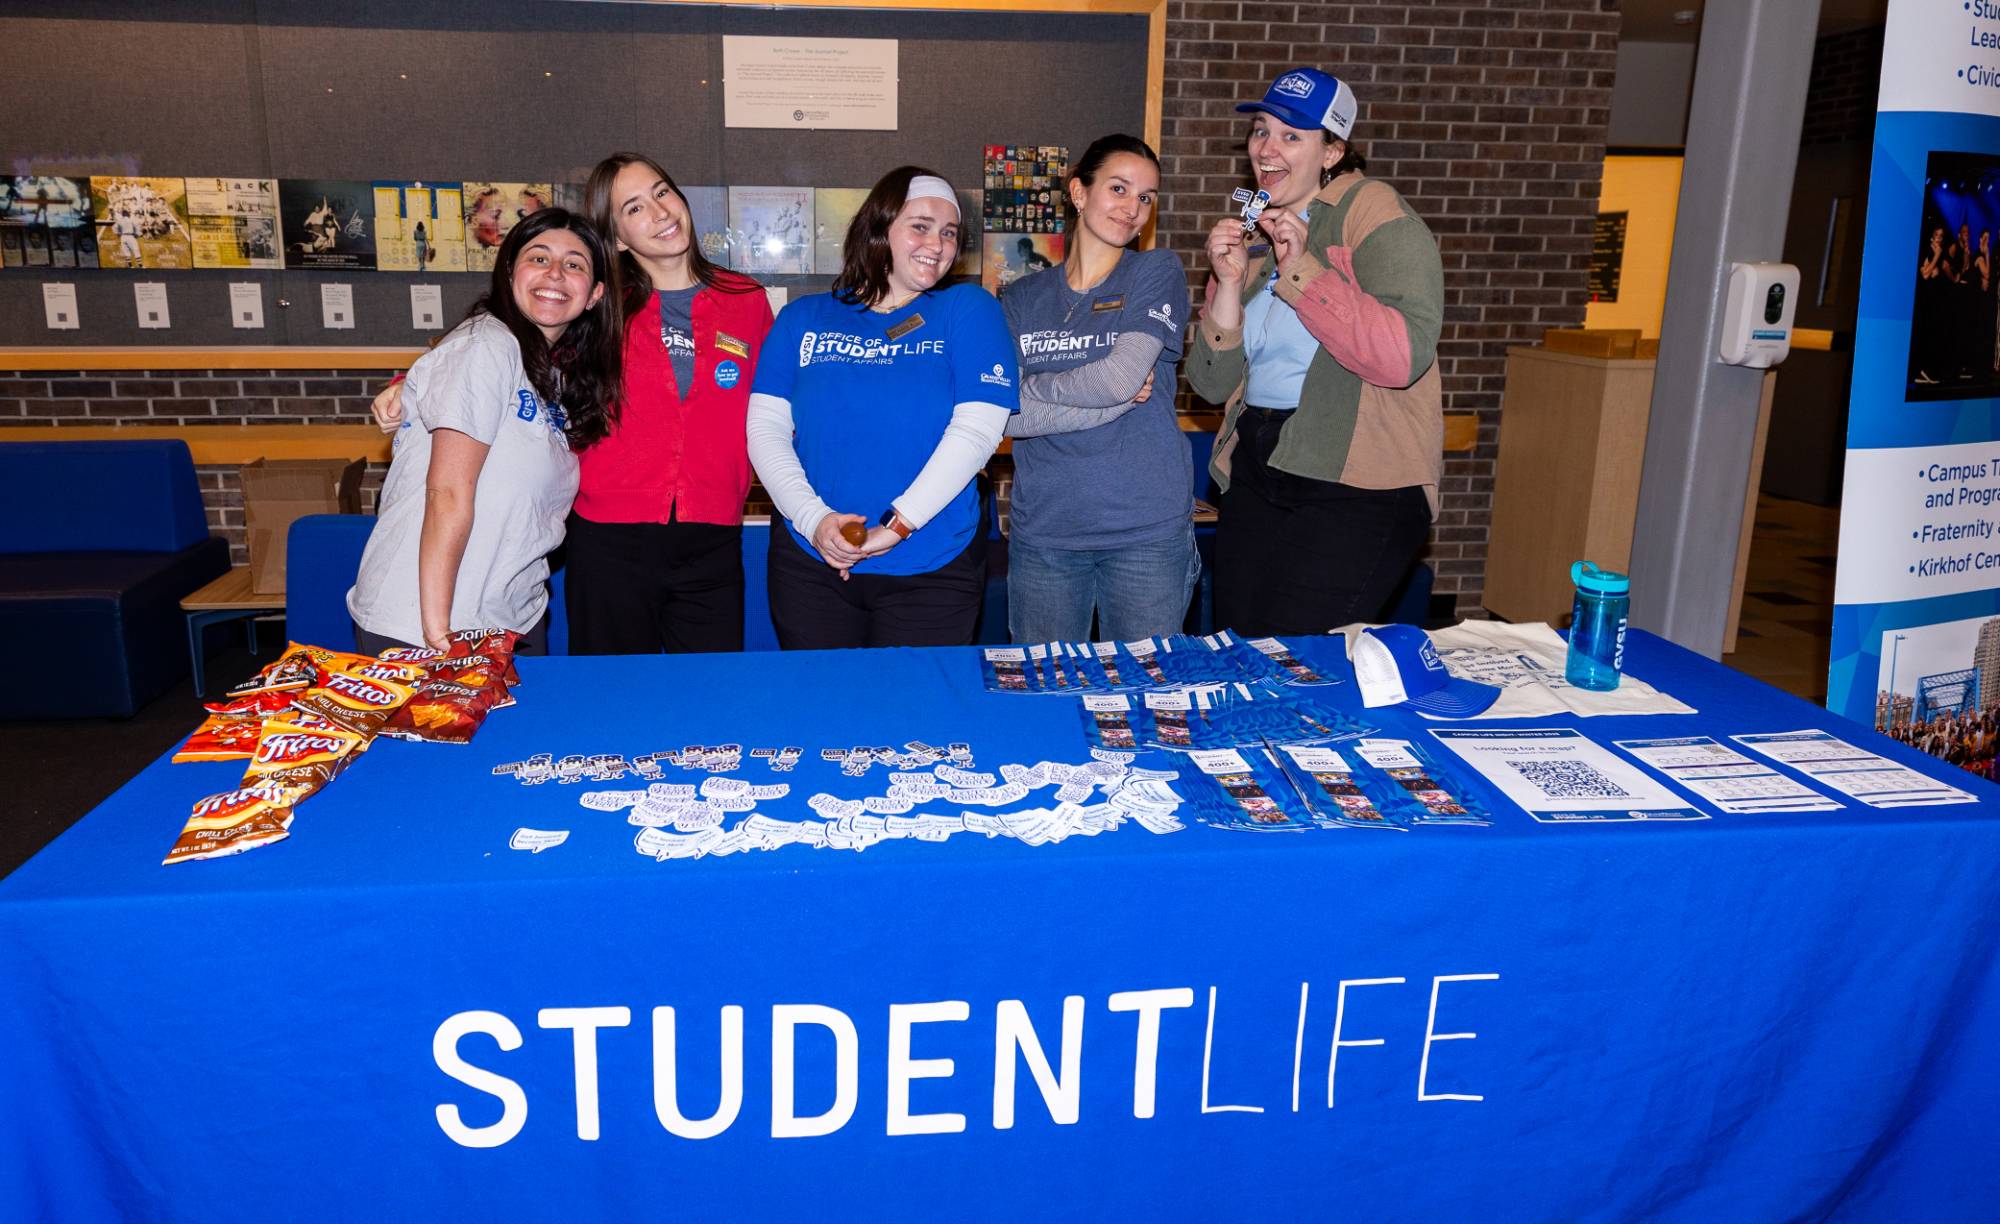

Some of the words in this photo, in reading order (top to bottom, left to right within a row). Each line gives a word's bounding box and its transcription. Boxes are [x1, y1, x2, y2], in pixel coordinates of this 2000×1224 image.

[819, 332, 862, 345] OFFICE
[864, 338, 883, 348] OF
[810, 355, 851, 365] STUDENT
[852, 357, 894, 366] AFFAIRS
[1026, 354, 1050, 365] TUDENT
[1052, 351, 1088, 362] AFFAIRS
[1928, 463, 1987, 483] Campus
[1925, 488, 1954, 508] and
[1921, 519, 1994, 543] Fraternity
[1918, 553, 1972, 577] Kirkhof
[1614, 618, 1627, 670] GVSU
[325, 672, 396, 705] Fritos
[424, 683, 480, 696] Doritos
[331, 705, 368, 719] CHEESE
[256, 733, 345, 764] Fritos
[273, 766, 314, 779] CHEESE
[195, 831, 221, 840] CHILI
